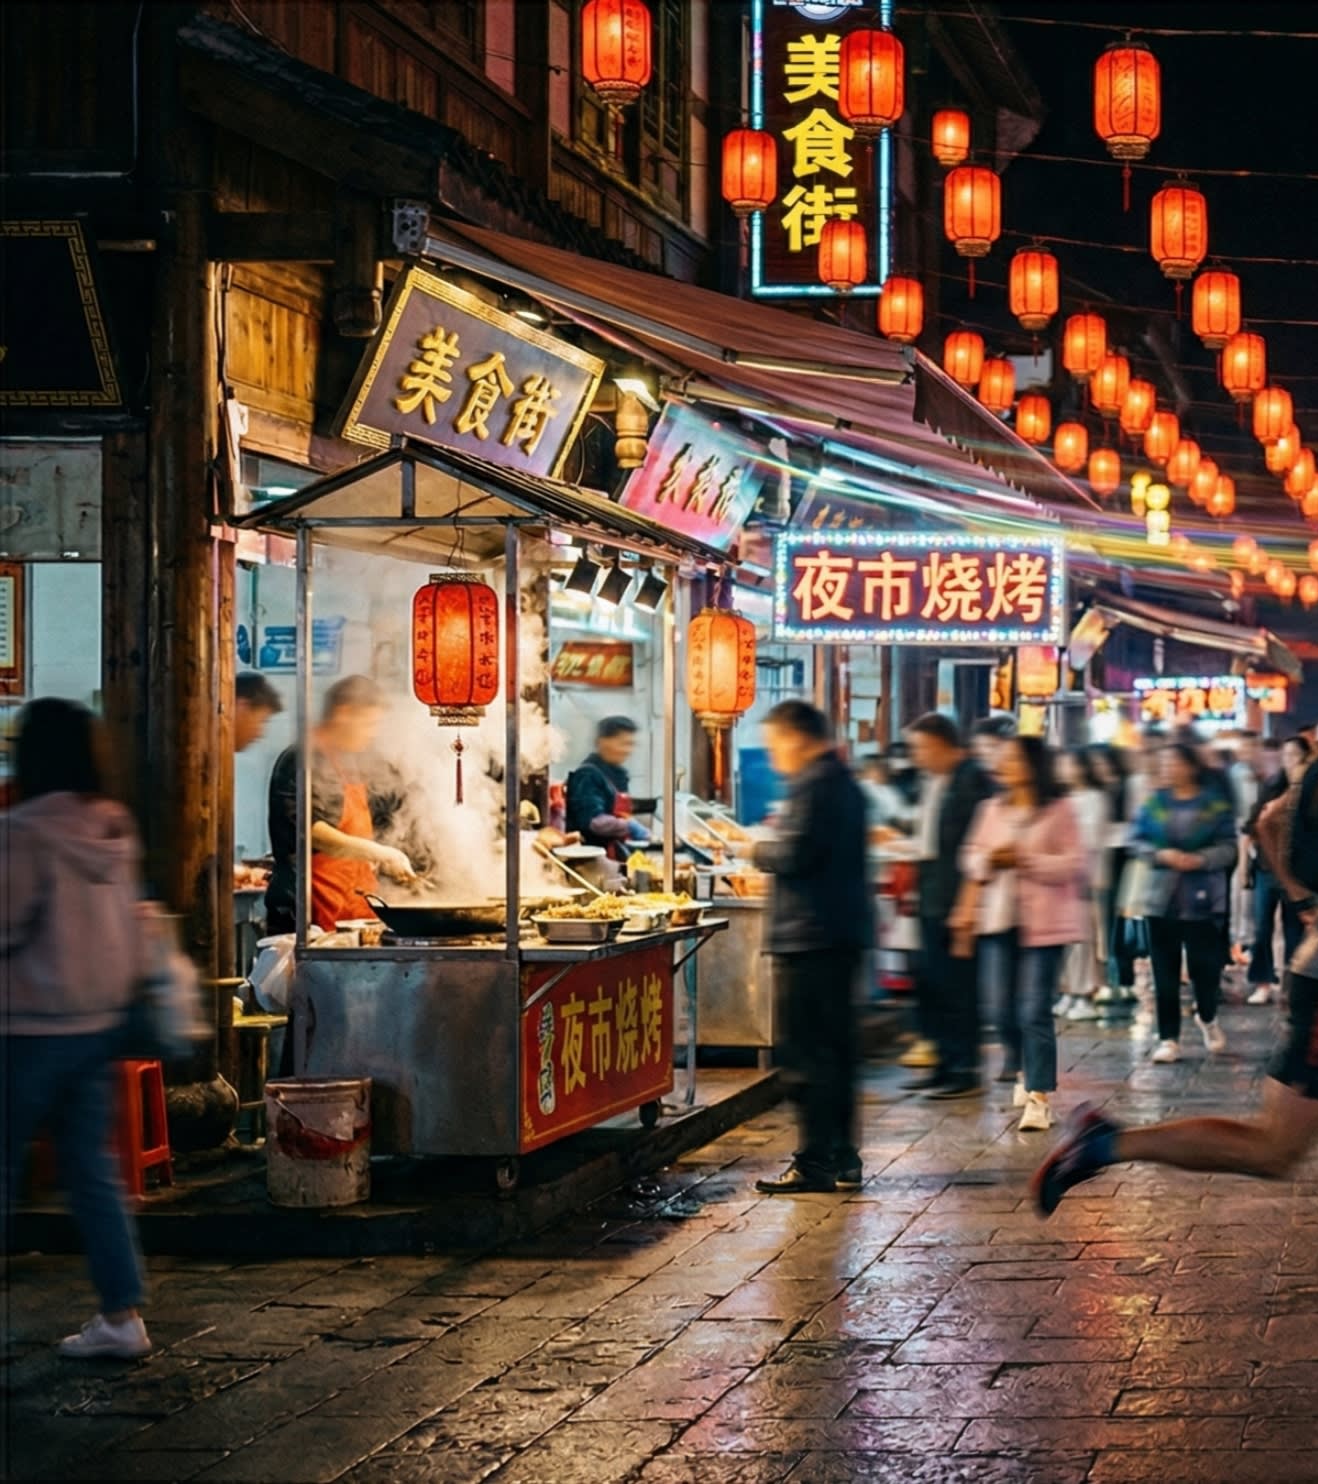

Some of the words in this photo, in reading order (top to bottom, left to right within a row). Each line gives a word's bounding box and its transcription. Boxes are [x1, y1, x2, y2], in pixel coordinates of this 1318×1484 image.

[781, 34, 858, 251] 美食街
[792, 549, 1048, 623] 夜市烧烤
[560, 972, 663, 1096] 夜市烧烤
